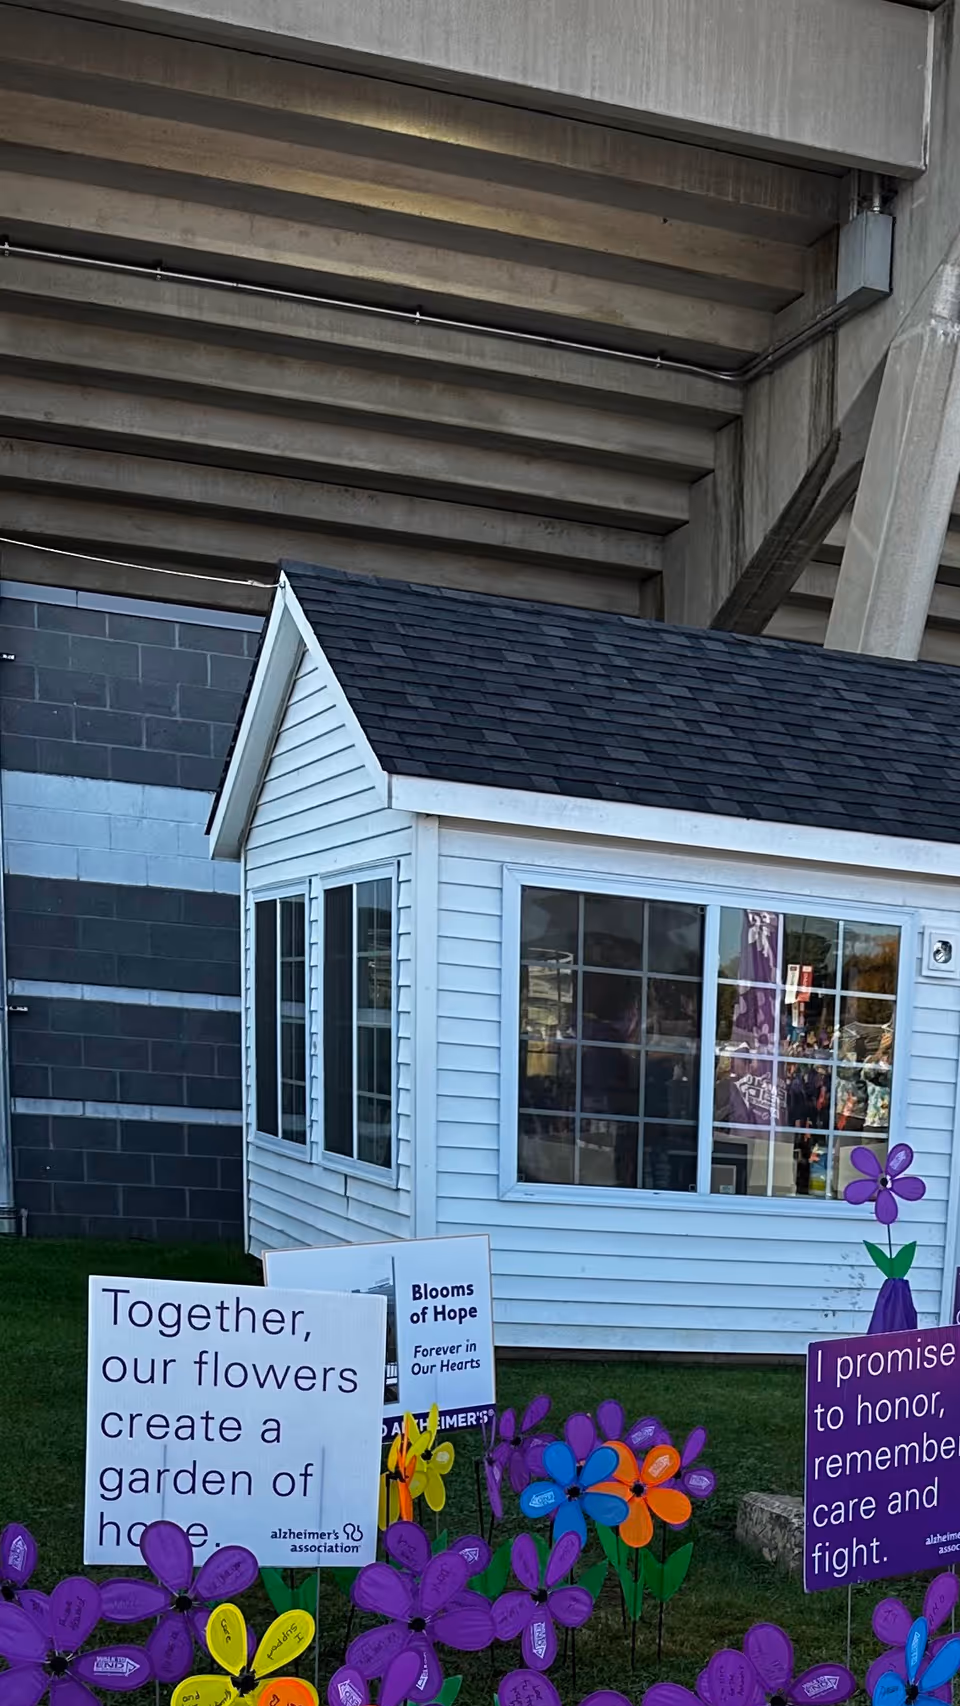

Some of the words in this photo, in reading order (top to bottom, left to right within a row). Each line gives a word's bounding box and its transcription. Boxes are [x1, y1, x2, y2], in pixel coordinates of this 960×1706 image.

[412, 1283, 474, 1301] Blooms
[101, 1288, 312, 1342] Together,
[410, 1306, 428, 1324] of
[434, 1305, 478, 1324] Hope
[411, 1362, 436, 1375] Our
[440, 1358, 480, 1373] Hearts
[414, 1344, 462, 1358] Forever
[465, 1339, 477, 1353] in
[816, 1350, 822, 1382] I
[836, 1338, 956, 1387] promise
[101, 1354, 177, 1385] our
[194, 1351, 358, 1393] flowers
[101, 1409, 243, 1442] create
[260, 1417, 282, 1444] a
[814, 1404, 844, 1432] to
[856, 1389, 946, 1426] honor,
[99, 1461, 253, 1502] garden
[272, 1463, 314, 1497] of
[812, 1497, 876, 1528] care
[887, 1477, 939, 1515] and
[98, 1511, 221, 1549] hoe.
[271, 1528, 339, 1542] alzheimer's
[290, 1541, 360, 1554] association
[812, 1537, 889, 1578] fight.
[182, 1691, 200, 1702] and
